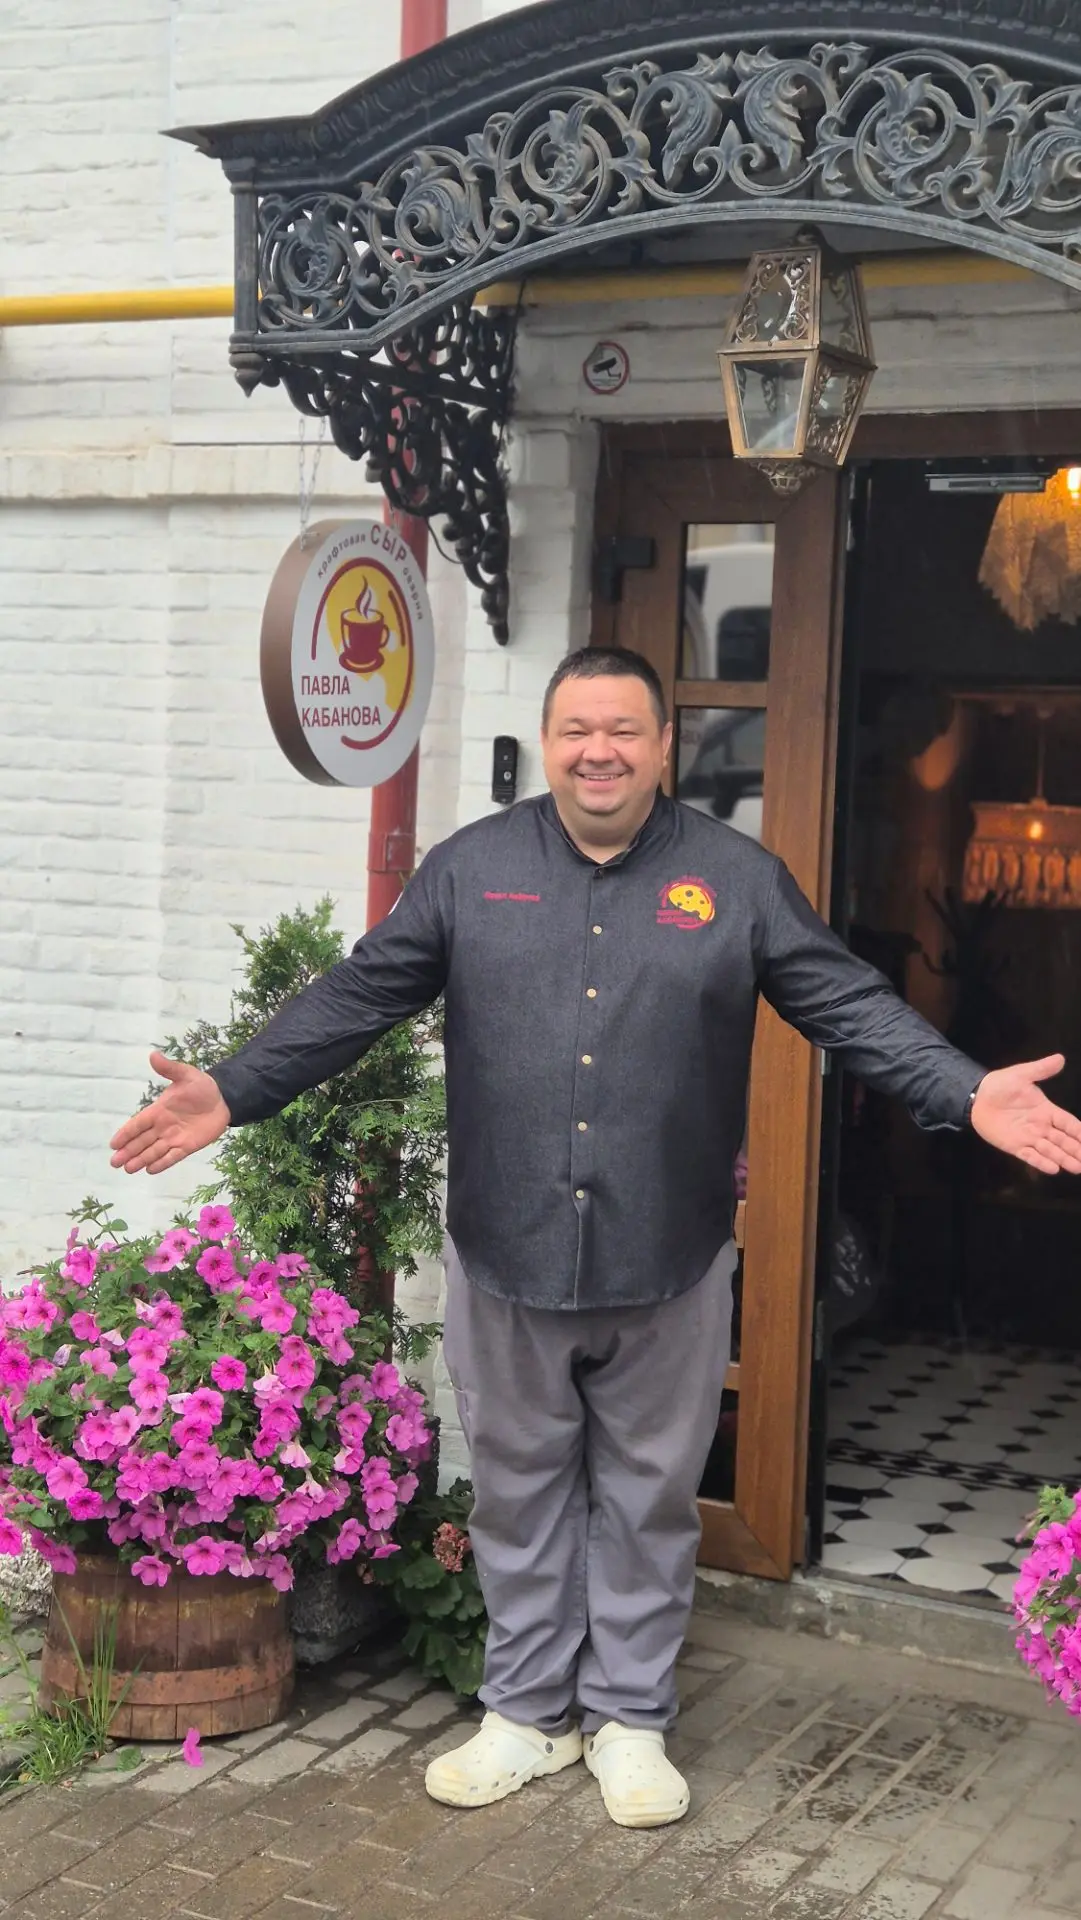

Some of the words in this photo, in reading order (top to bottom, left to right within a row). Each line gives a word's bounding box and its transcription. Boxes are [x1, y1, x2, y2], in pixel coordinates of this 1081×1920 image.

[317, 533, 366, 579] крафтовая
[301, 675, 351, 695] ПАВЛА
[301, 705, 382, 727] КАБАНОВА
